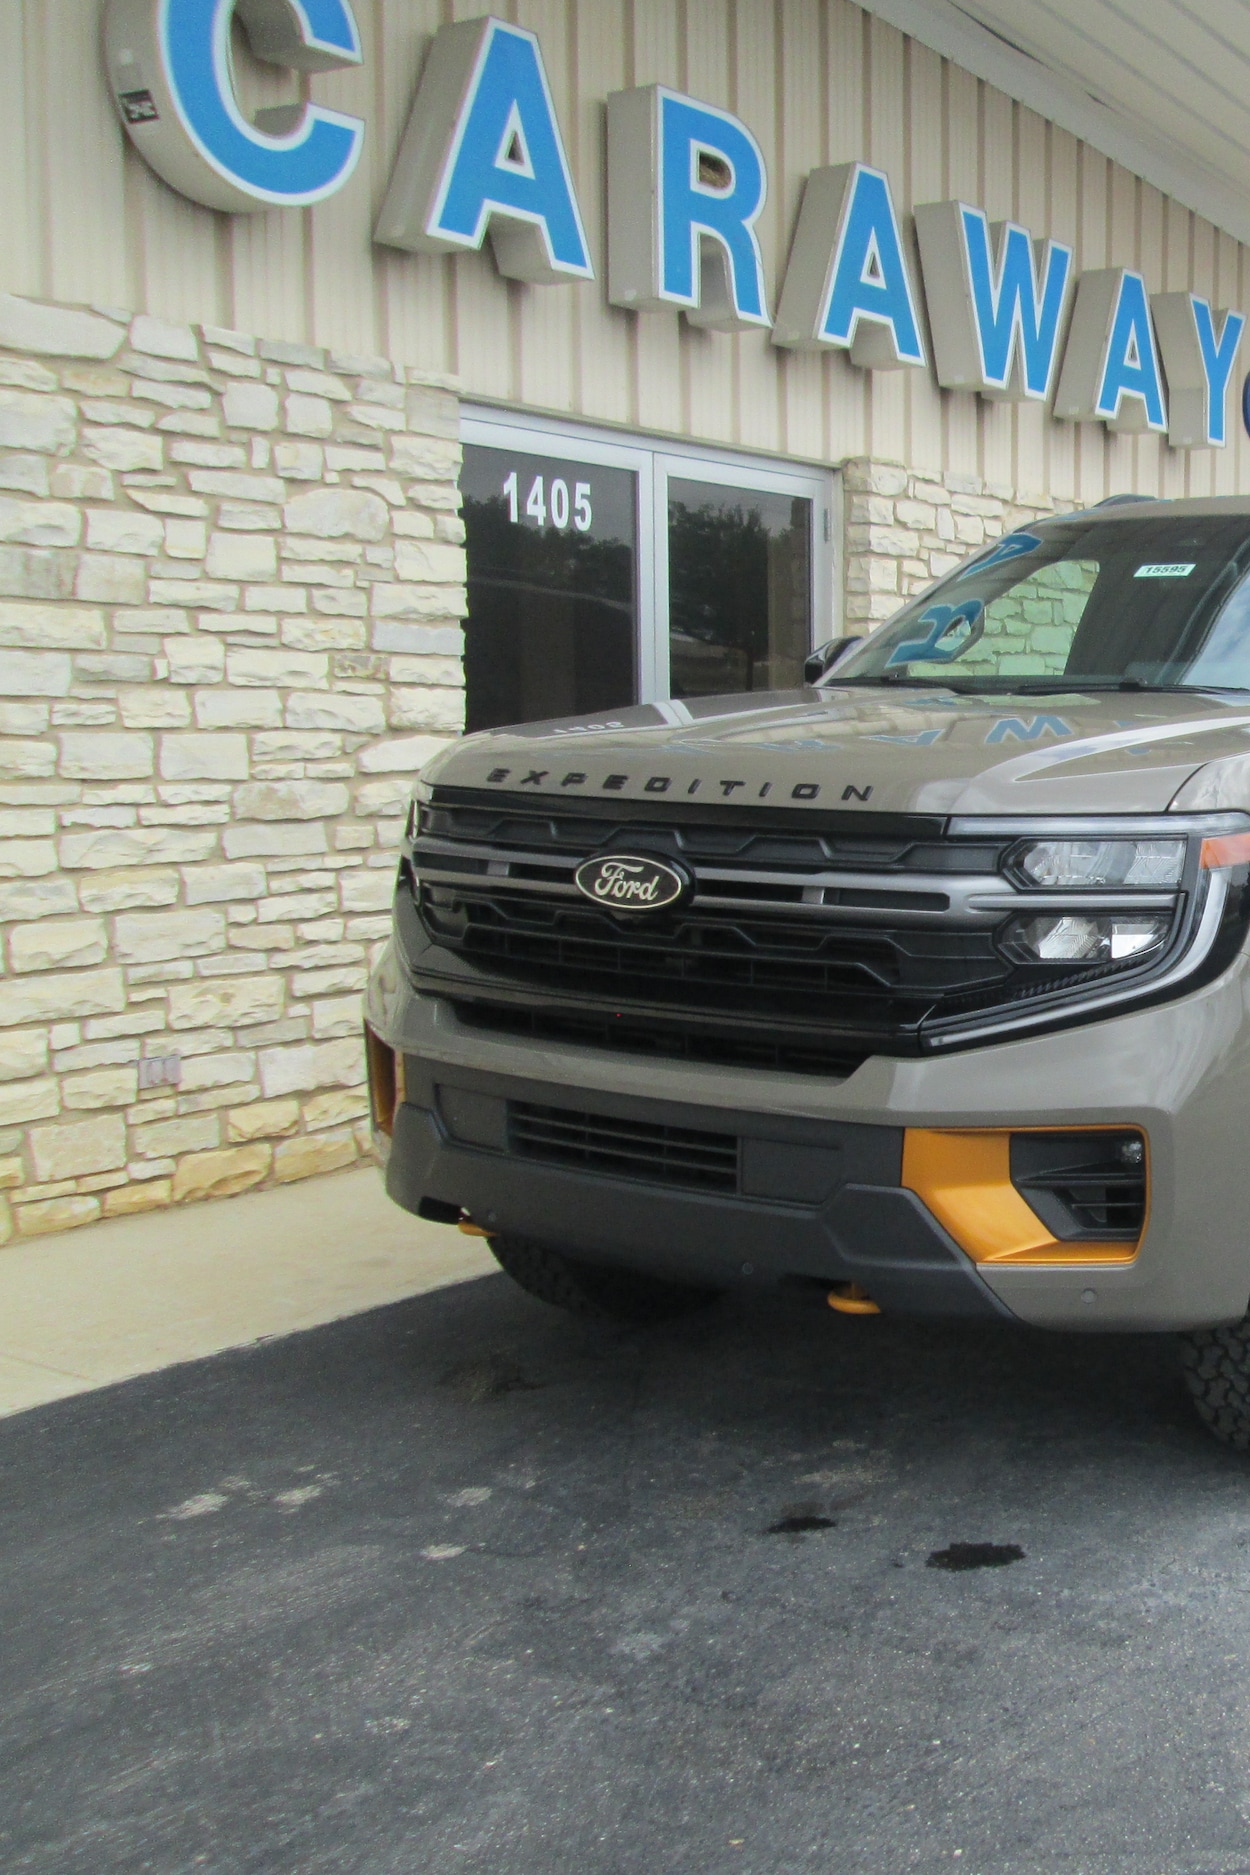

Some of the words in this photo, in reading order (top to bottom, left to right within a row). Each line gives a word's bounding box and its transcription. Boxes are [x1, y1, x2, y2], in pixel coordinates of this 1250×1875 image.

[150, 0, 1247, 449] CARAWAY
[503, 471, 593, 532] 1405
[1144, 565, 1187, 574] 15595
[487, 768, 874, 801] EXPEDITION
[594, 861, 660, 901] Ford
